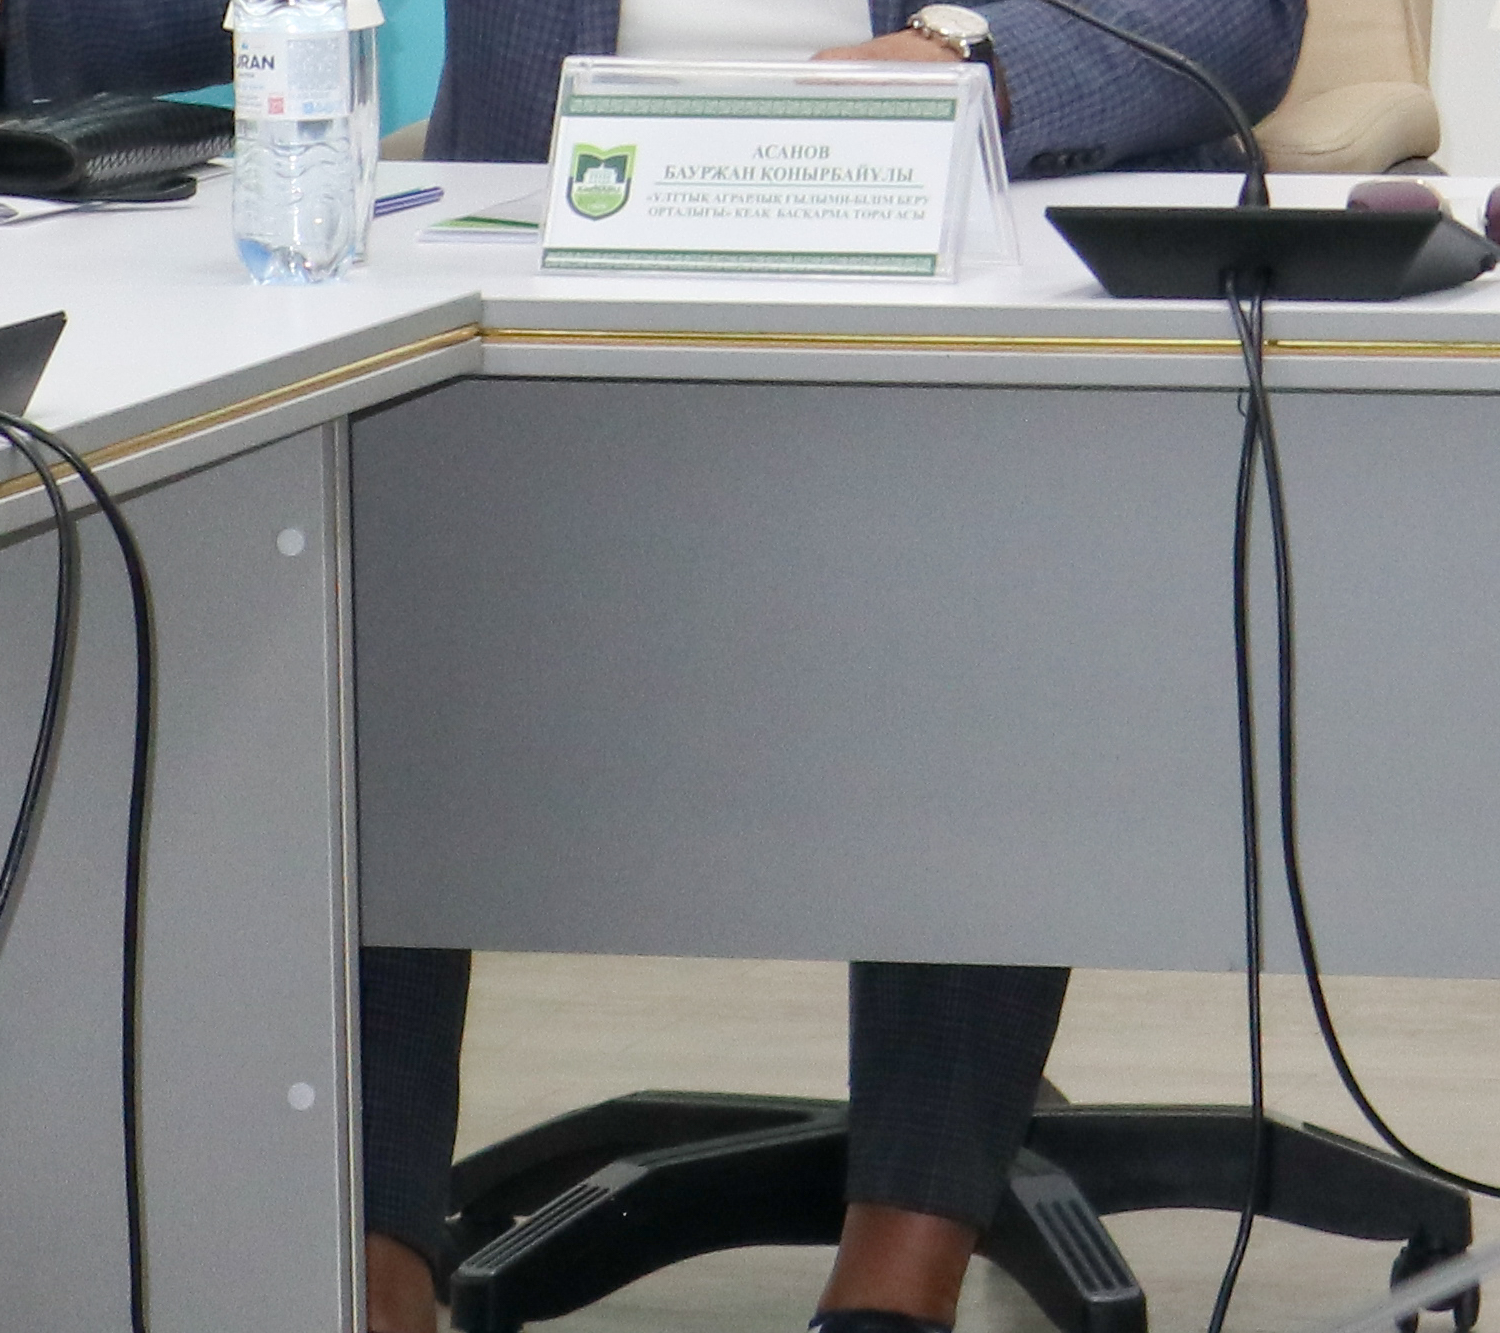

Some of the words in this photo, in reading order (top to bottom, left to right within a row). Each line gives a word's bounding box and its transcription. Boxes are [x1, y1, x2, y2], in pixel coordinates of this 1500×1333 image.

[236, 54, 275, 71] RAN
[752, 143, 831, 161] АСАНОВ
[663, 164, 756, 182] БАУРЖАН
